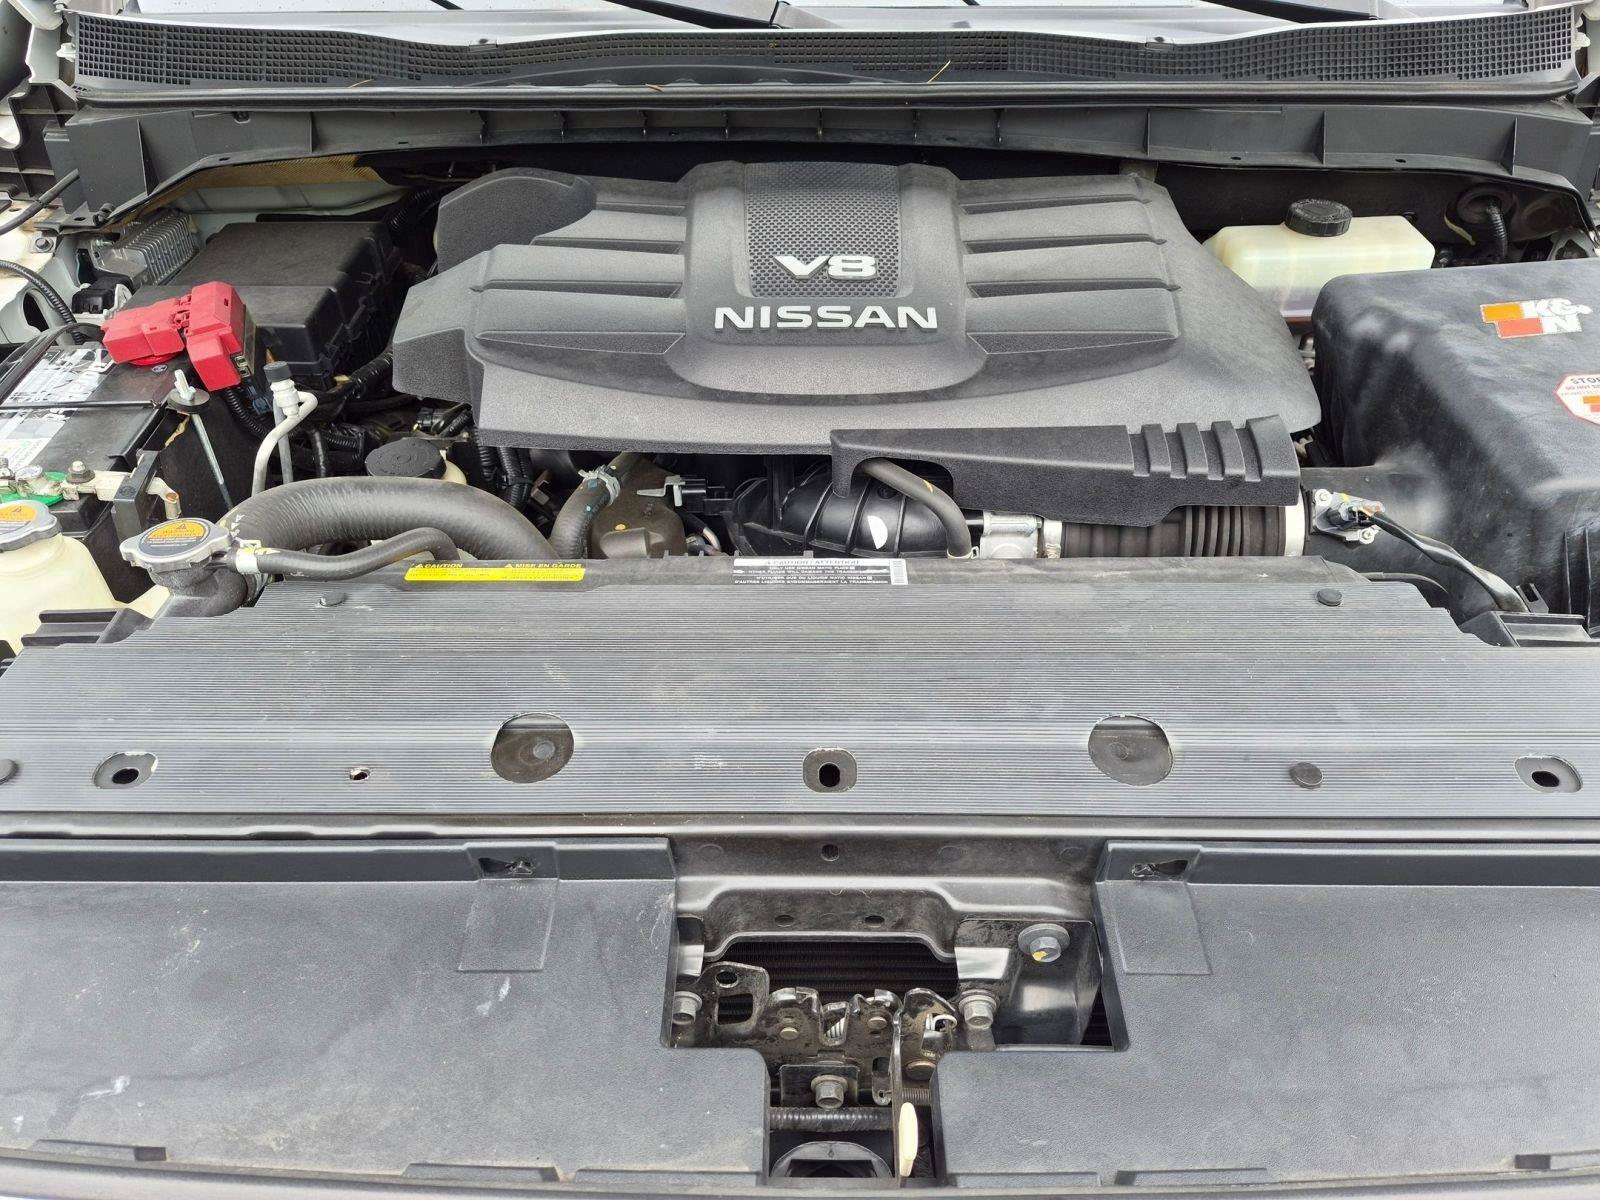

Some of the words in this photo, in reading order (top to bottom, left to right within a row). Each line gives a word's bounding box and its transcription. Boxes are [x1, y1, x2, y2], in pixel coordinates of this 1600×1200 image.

[774, 256, 877, 280] V8
[714, 305, 938, 330] NISSAN
[1519, 298, 1593, 335] K&N
